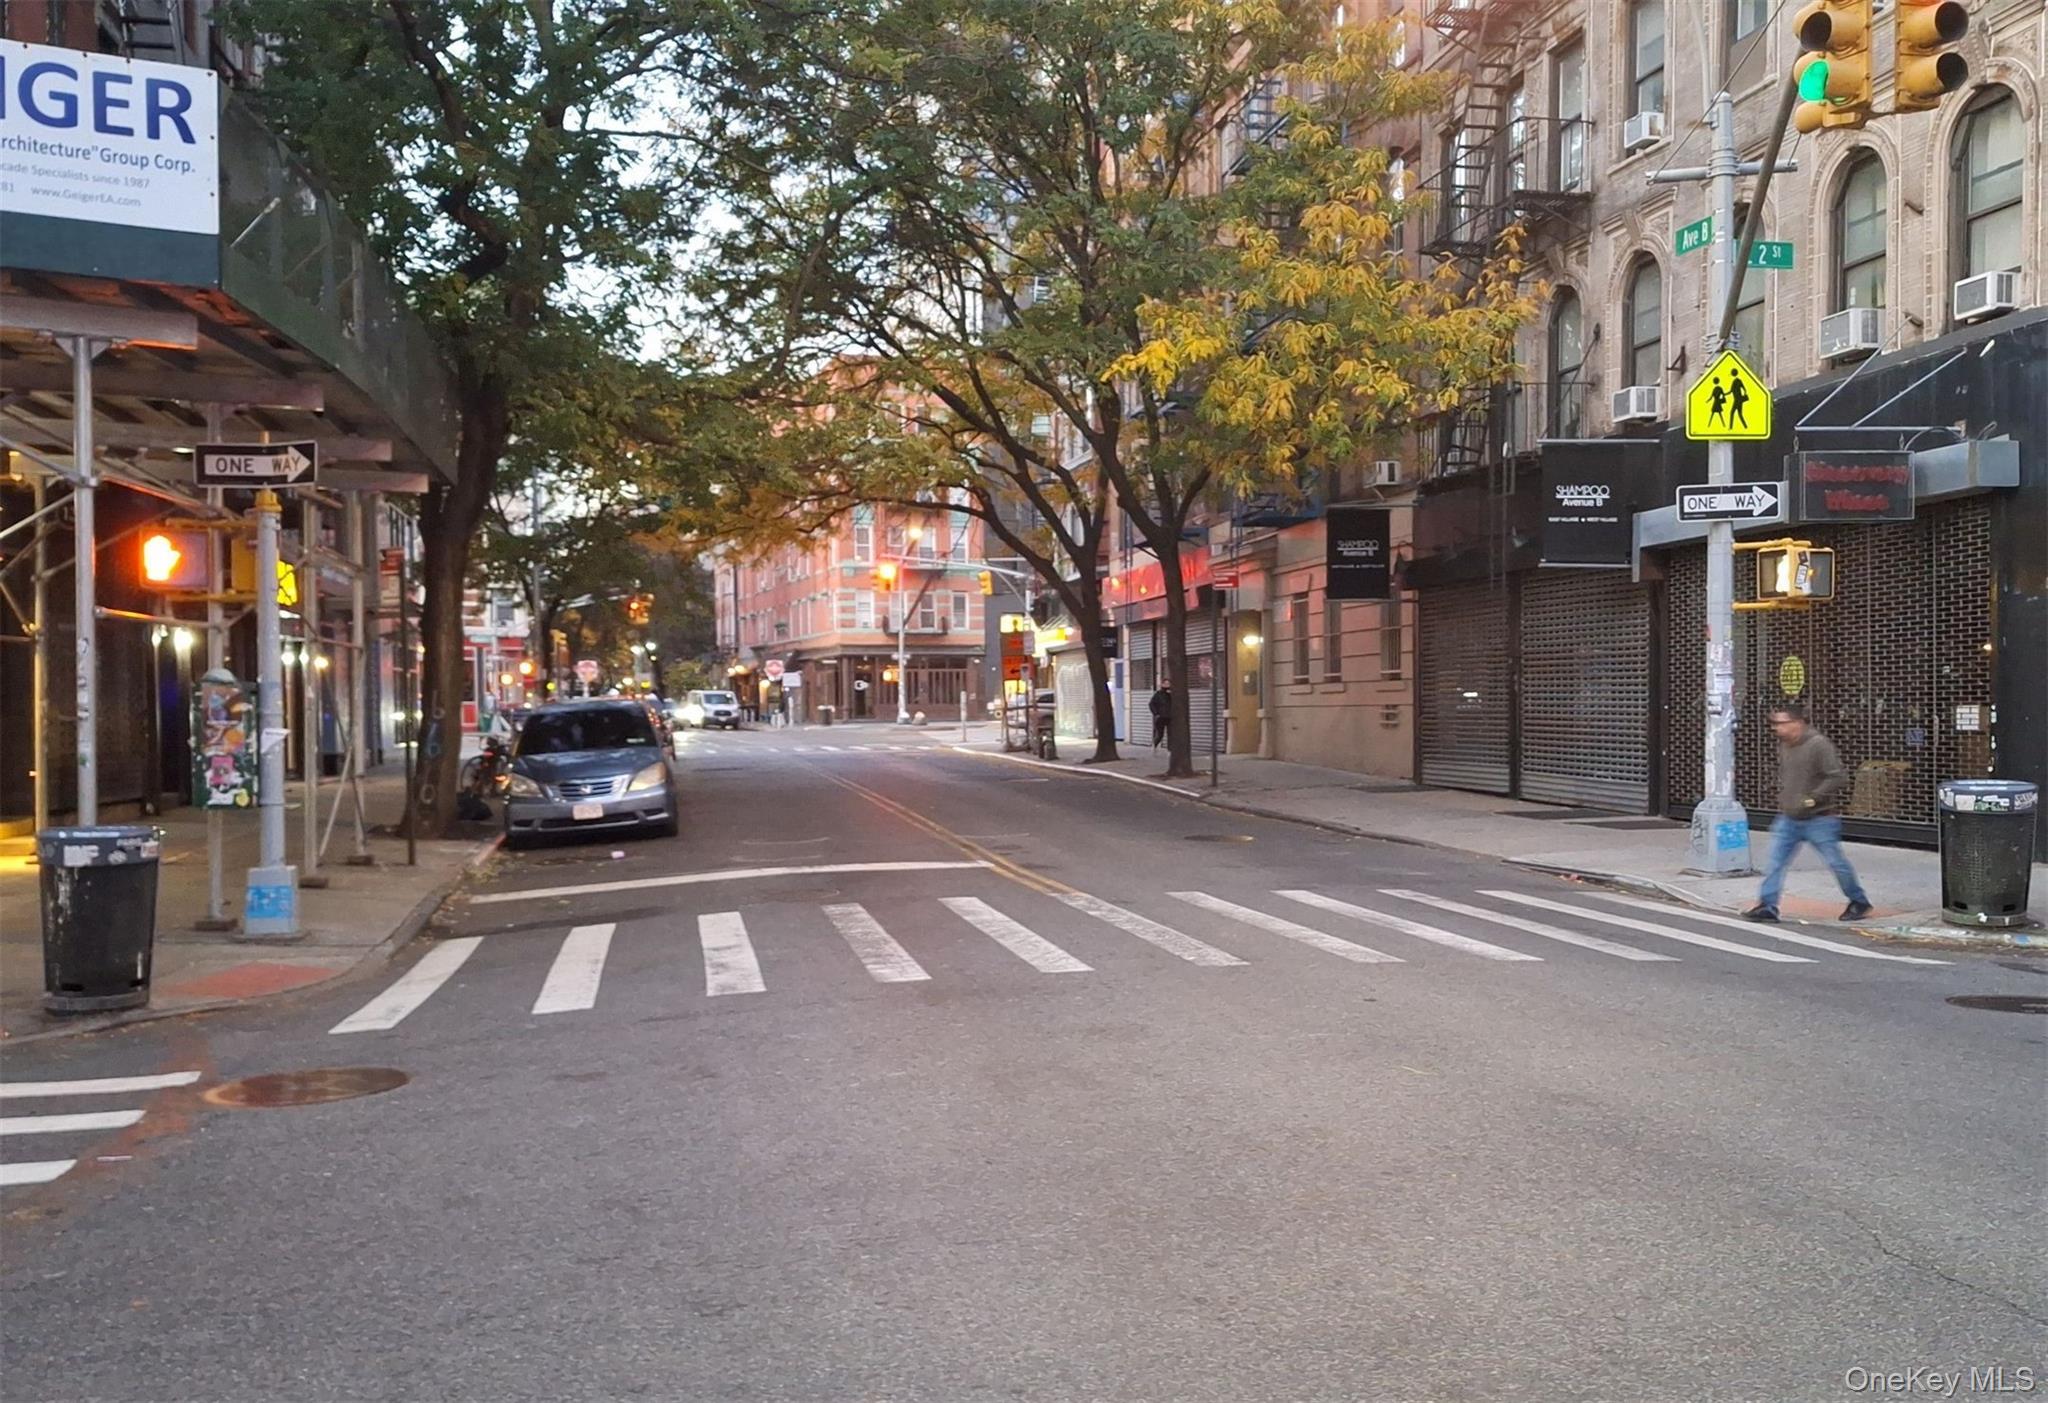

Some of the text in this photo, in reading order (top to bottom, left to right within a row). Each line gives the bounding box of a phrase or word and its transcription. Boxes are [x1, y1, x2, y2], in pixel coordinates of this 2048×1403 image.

[100, 147, 150, 171] Group
[154, 154, 197, 175] Corp.
[0, 161, 151, 189] cade Specialists since 1987
[1682, 221, 1709, 251] Ave B
[1758, 244, 1782, 265] 2 St
[215, 456, 301, 474] ONE WAY
[1555, 484, 1610, 497] SHAMPOO
[1562, 498, 1604, 507] Avenue B
[1687, 494, 1766, 510] ONE WAY
